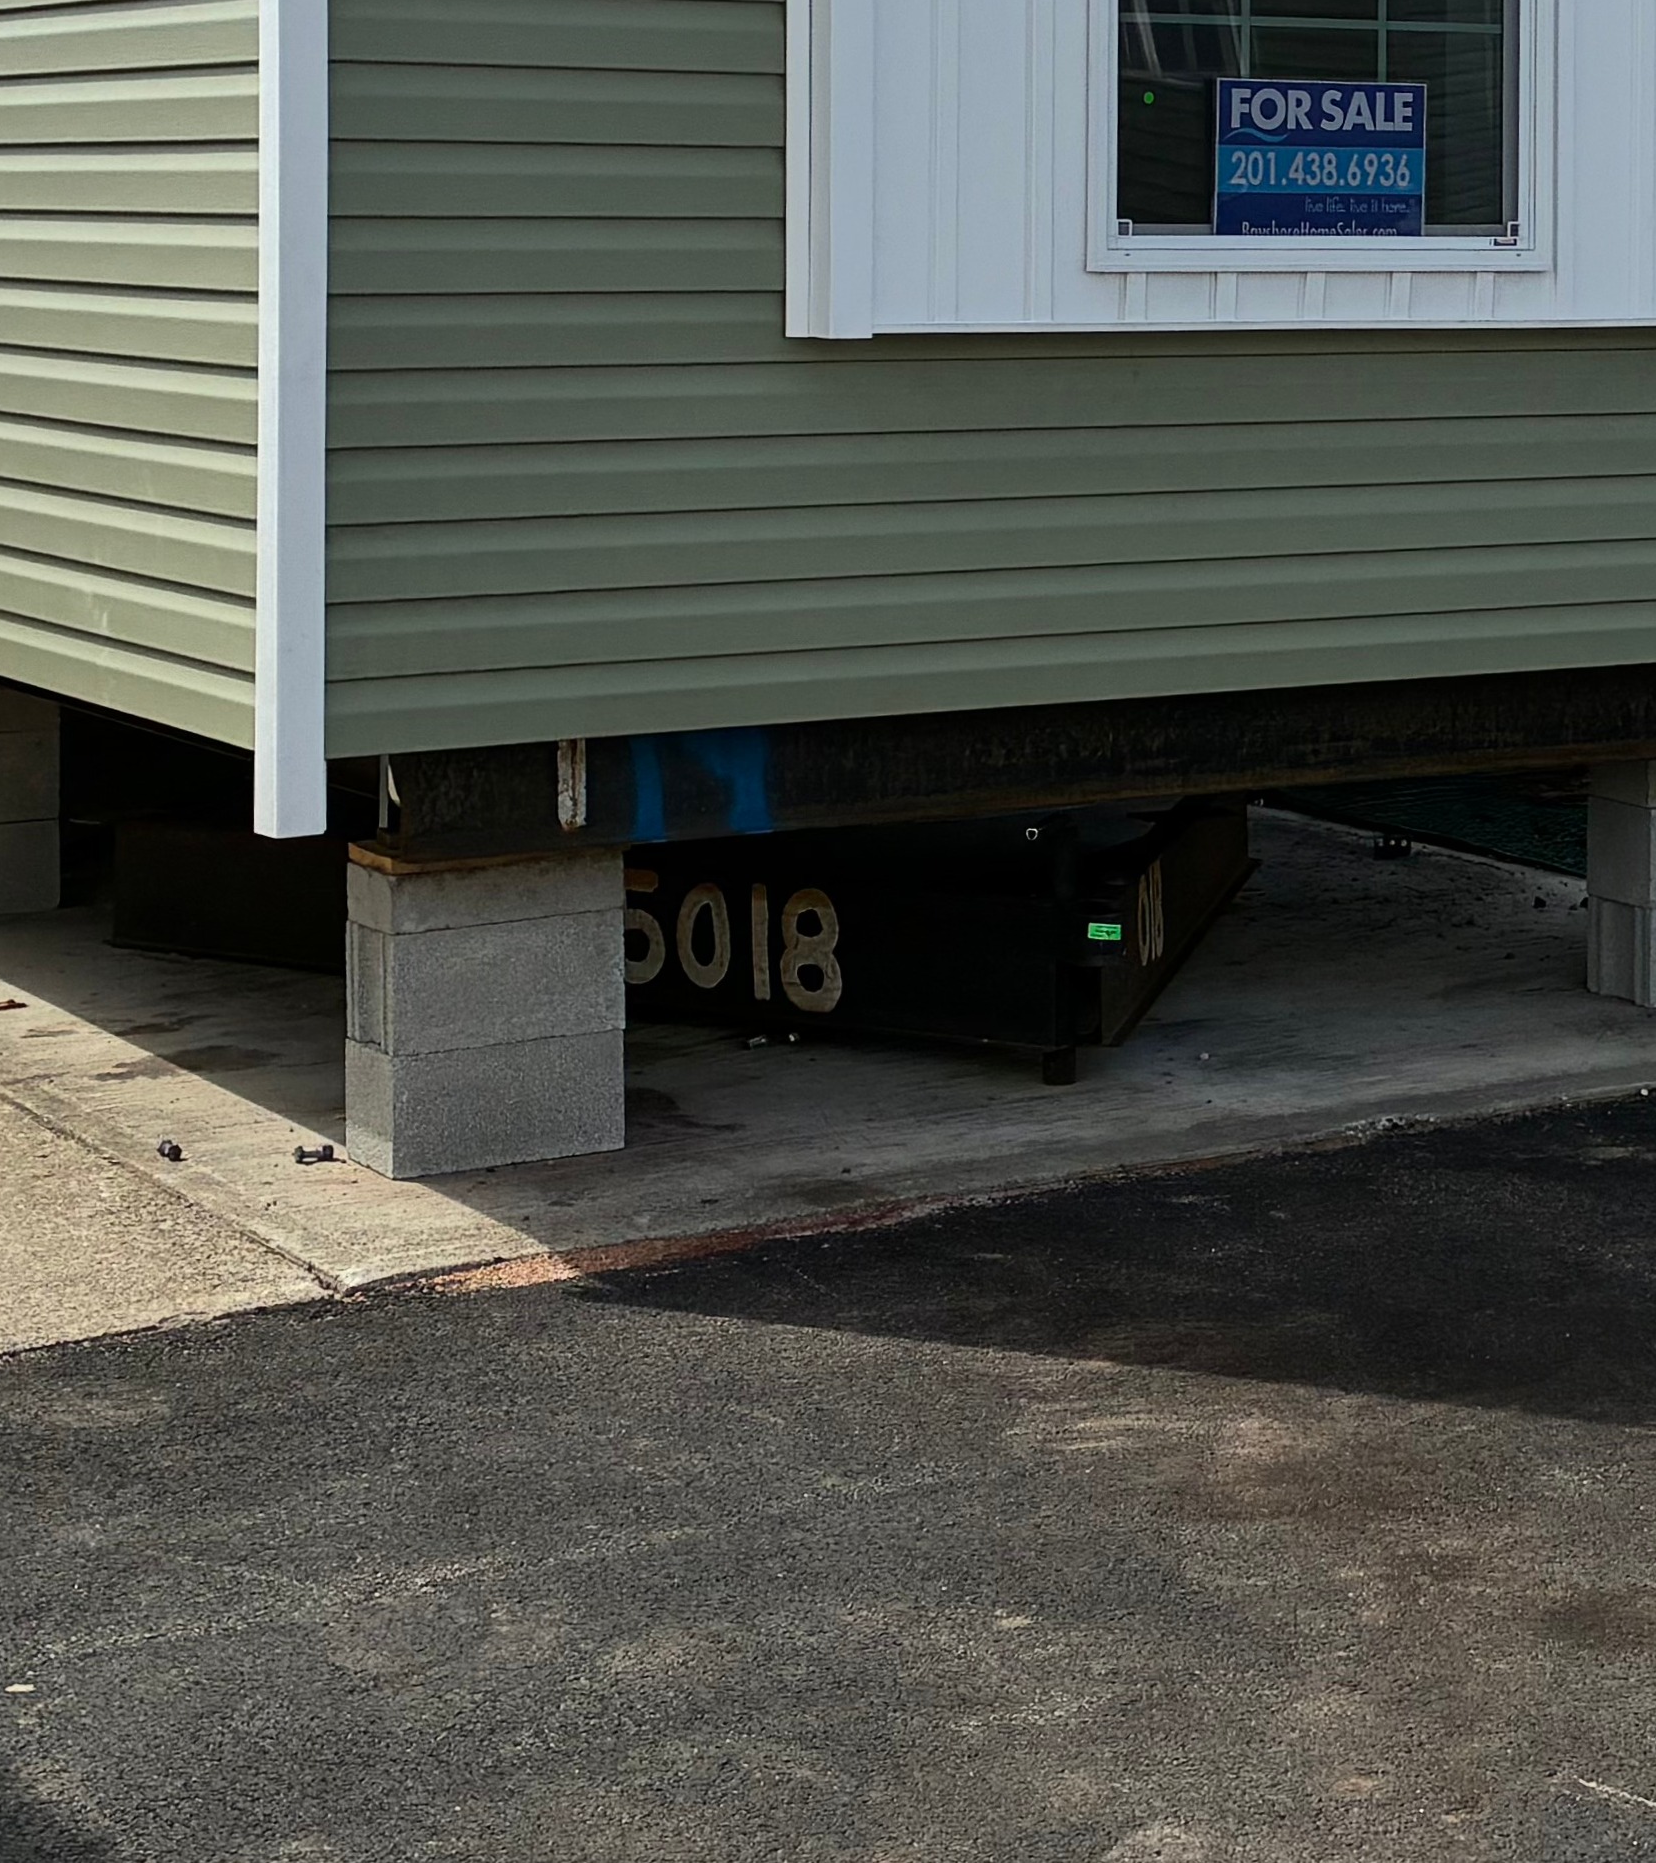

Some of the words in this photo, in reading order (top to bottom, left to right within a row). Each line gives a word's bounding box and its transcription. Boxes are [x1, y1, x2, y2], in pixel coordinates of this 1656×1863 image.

[1230, 88, 1313, 130] FOR
[1320, 90, 1413, 131] SALE
[1230, 151, 1410, 187] 201.438.6936
[1241, 220, 1398, 236] BayshoreHomeSalescom
[624, 868, 843, 1013] 5018
